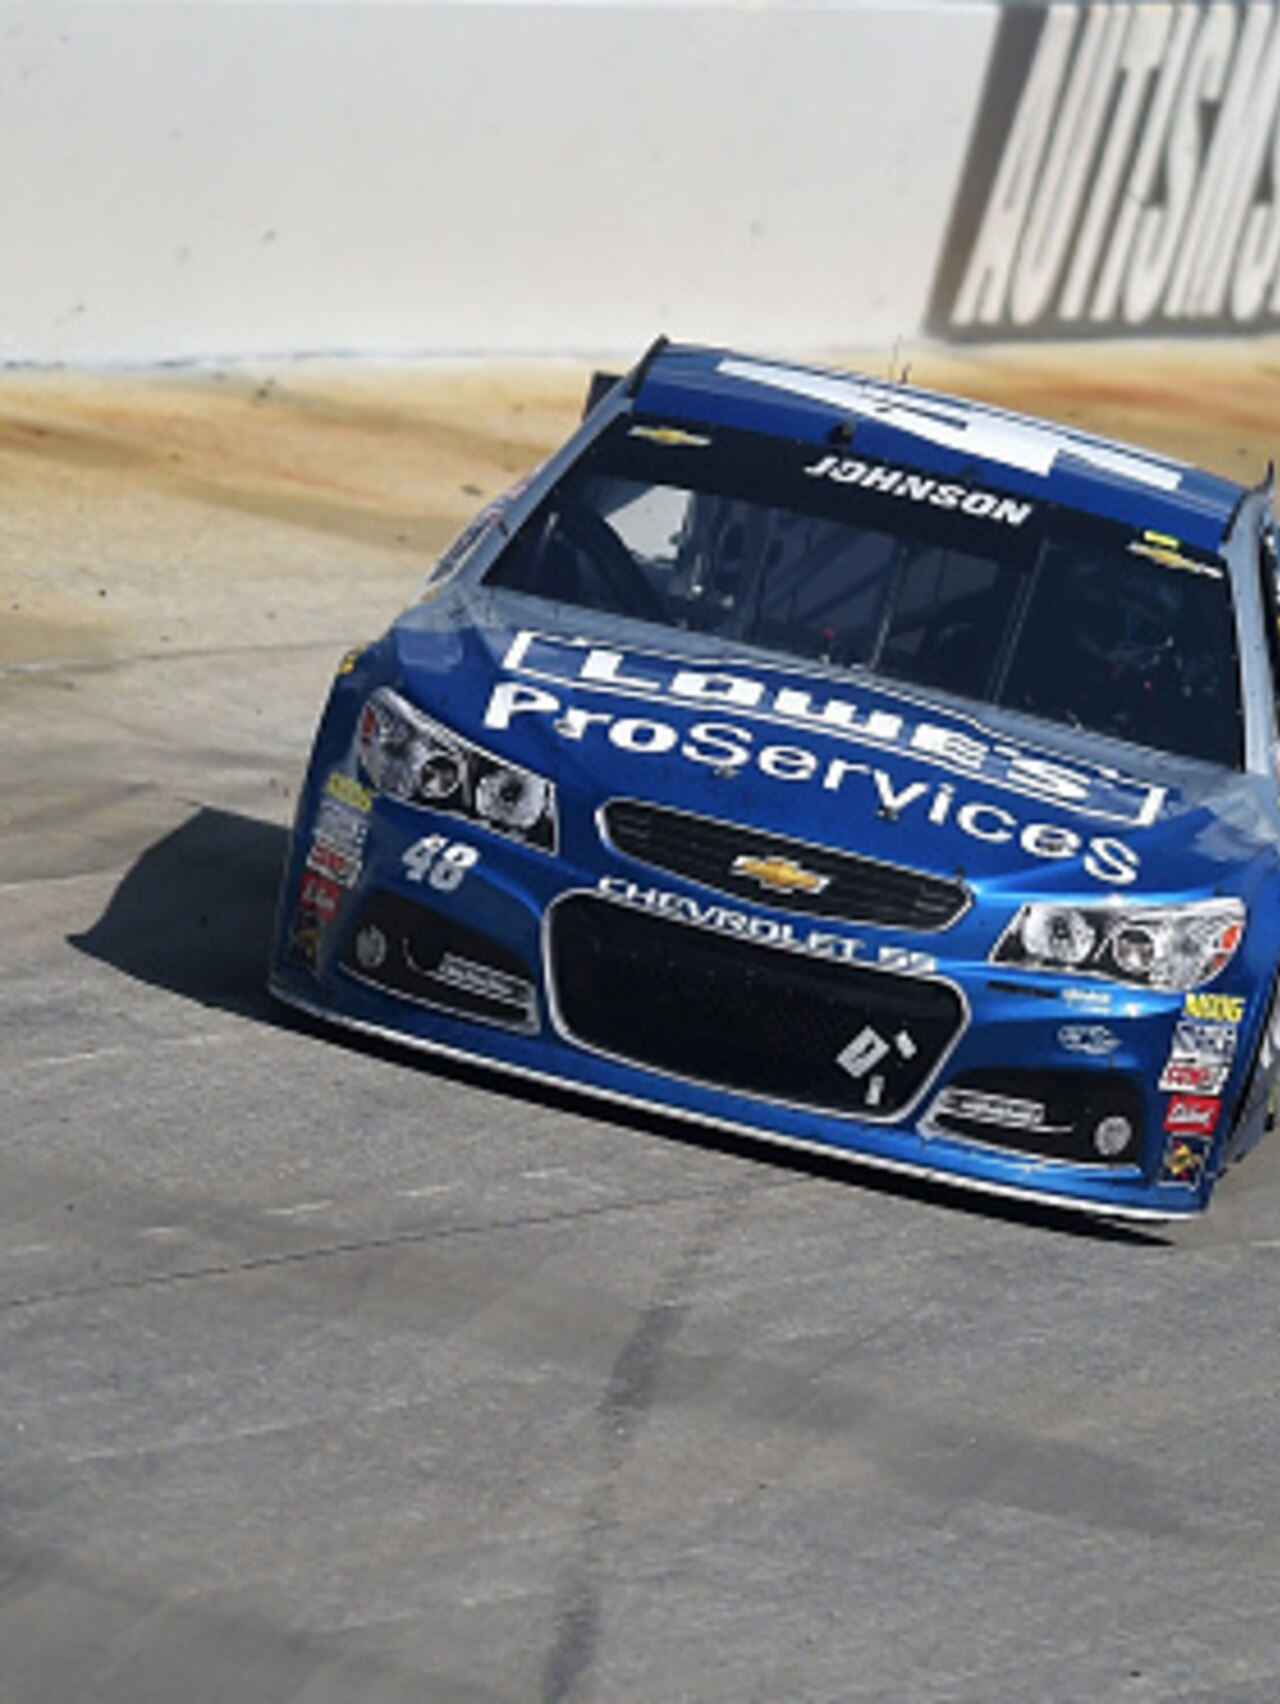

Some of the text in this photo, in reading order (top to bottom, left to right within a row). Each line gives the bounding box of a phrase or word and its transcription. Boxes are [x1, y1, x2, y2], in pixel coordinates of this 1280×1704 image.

[803, 456, 1033, 526] JOHNSON
[484, 680, 1140, 886] ProServices
[402, 833, 480, 892] 48
[598, 876, 866, 962] CHEVROLET
